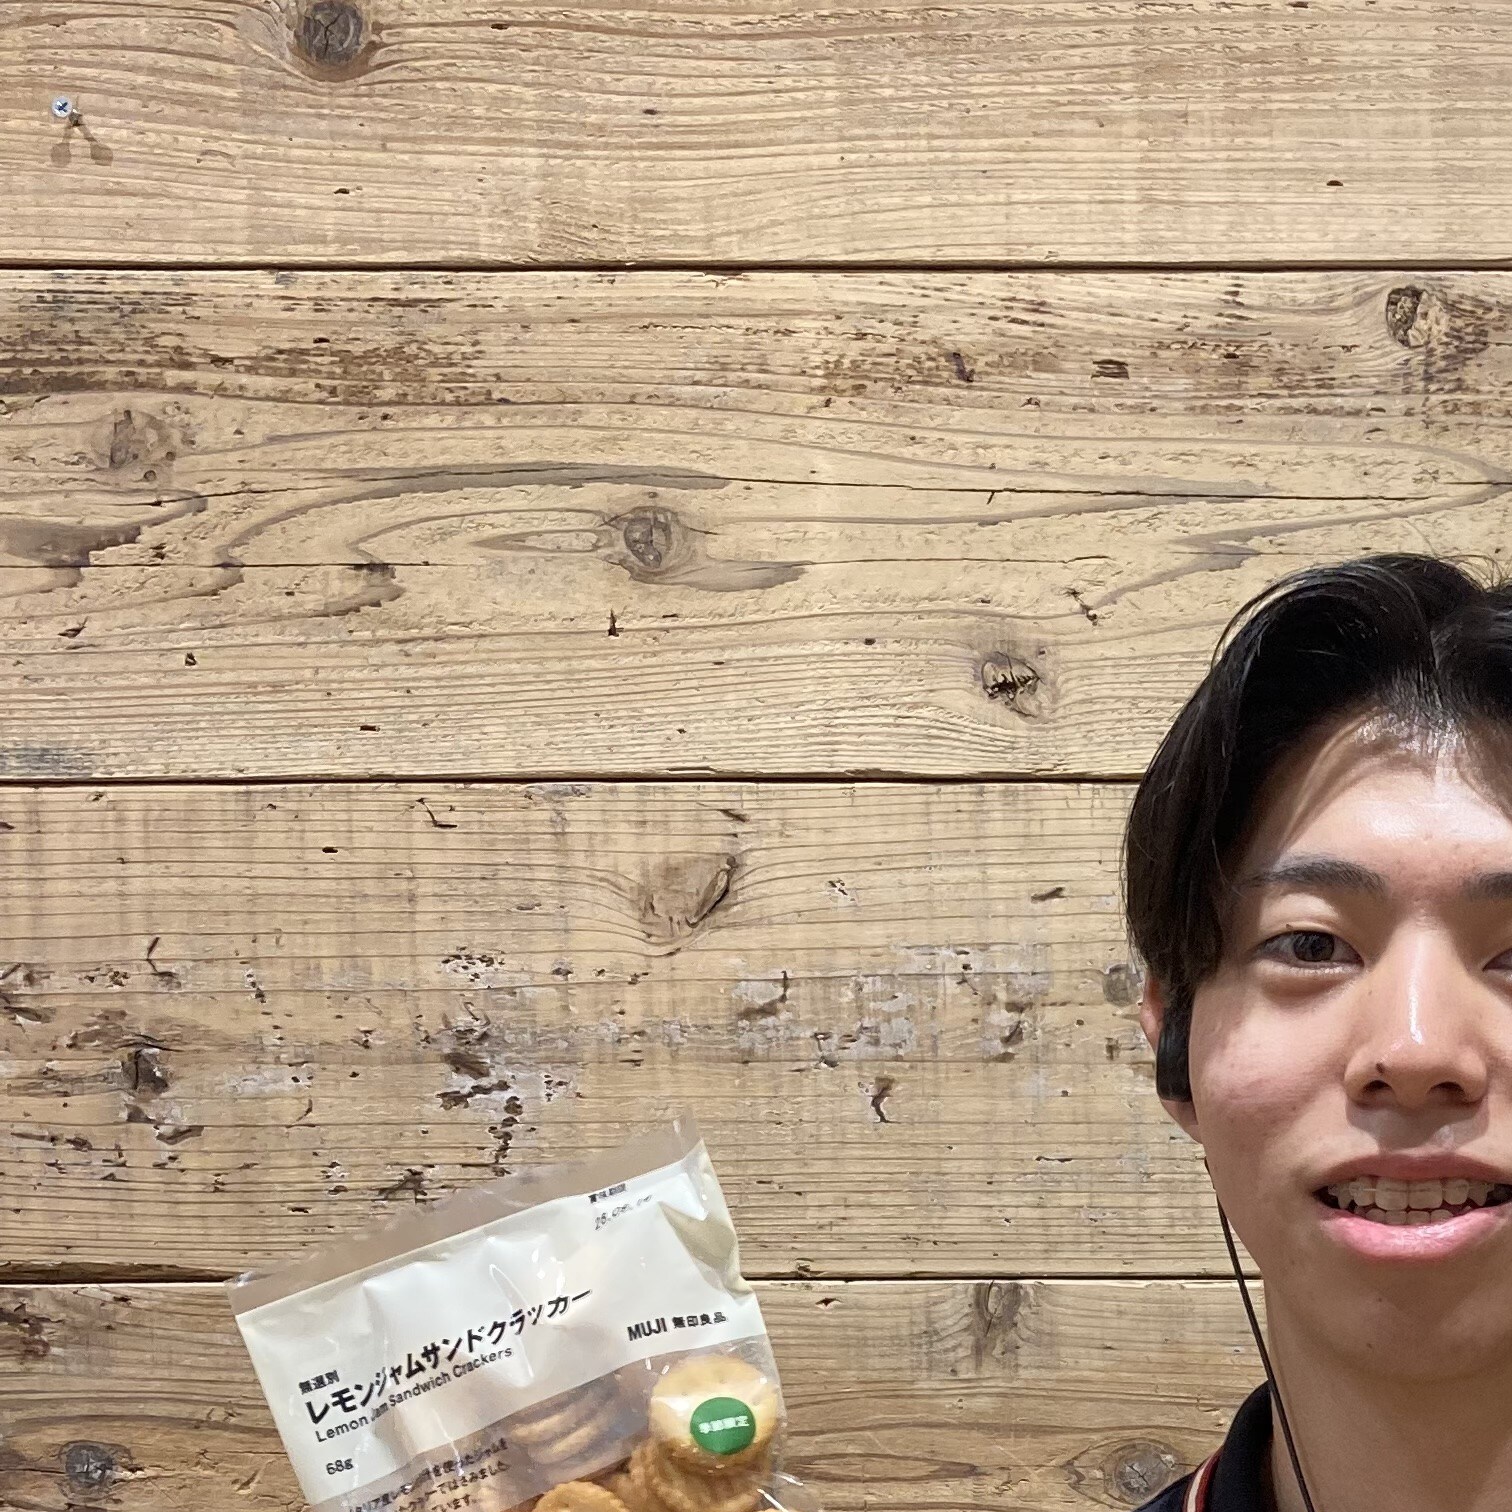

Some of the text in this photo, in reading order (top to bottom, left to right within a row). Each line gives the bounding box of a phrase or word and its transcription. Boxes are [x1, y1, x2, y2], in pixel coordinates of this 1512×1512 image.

[305, 1289, 592, 1424] レモンジャムサンドクラッカー
[627, 1311, 727, 1342] MUJI 無印良品
[315, 1414, 369, 1443] Lemon
[388, 1372, 452, 1407] Sandwich
[452, 1346, 513, 1378] Crackers
[326, 1458, 353, 1475] 68g
